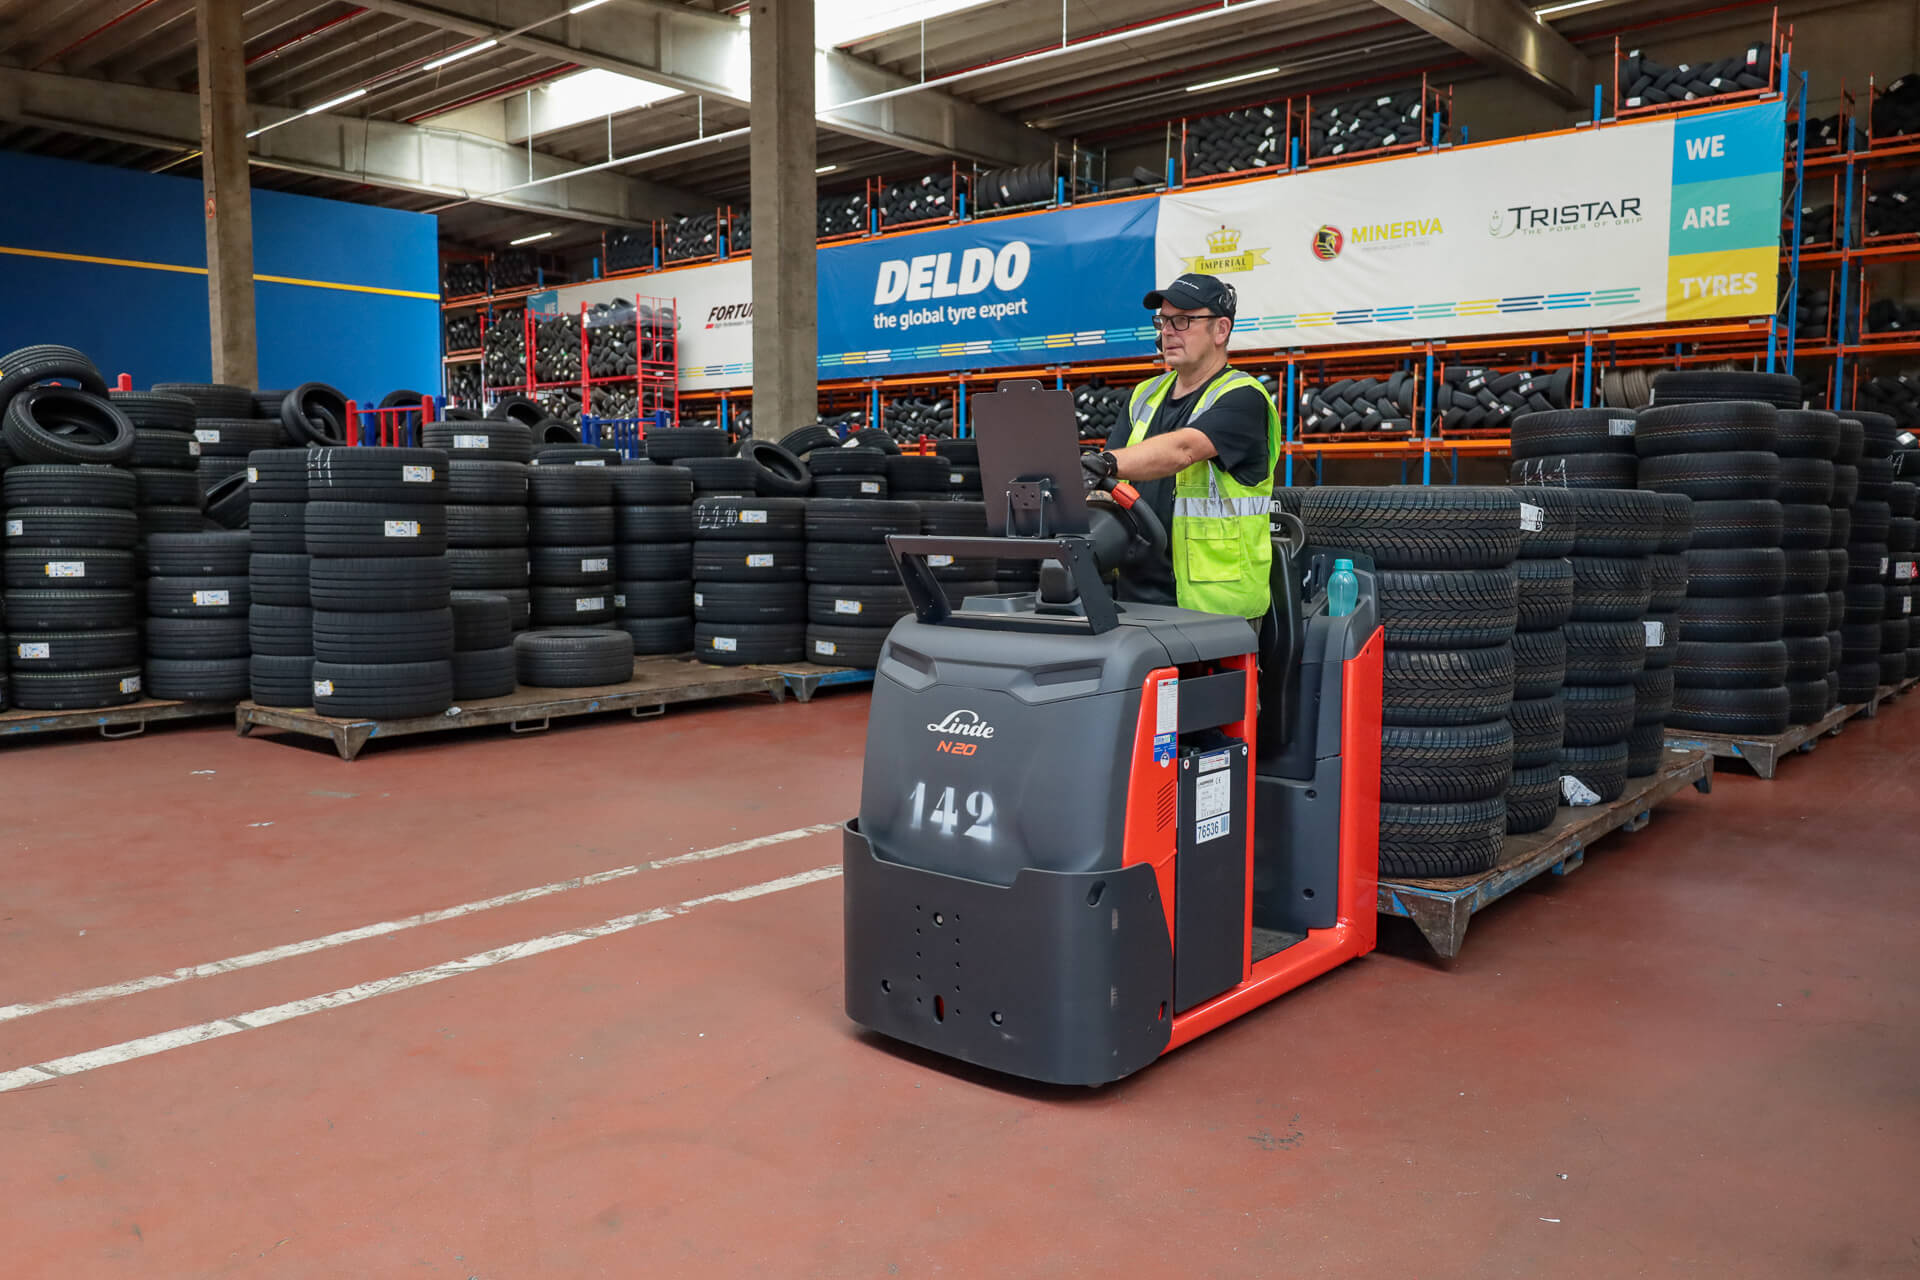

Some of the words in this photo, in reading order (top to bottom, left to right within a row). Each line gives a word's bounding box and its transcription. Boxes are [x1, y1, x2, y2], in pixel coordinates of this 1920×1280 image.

[1686, 134, 1725, 160] WE
[1507, 198, 1641, 229] TRISTAR
[1682, 204, 1730, 230] ARE
[1351, 217, 1443, 244] MINERVA
[873, 241, 1031, 305] DELDO
[1200, 258, 1247, 271] IMPERIAL
[1679, 272, 1758, 299] TYRES
[873, 313, 897, 329] the
[899, 306, 945, 330] global
[947, 306, 977, 325] tyre
[979, 298, 1028, 320] expert
[927, 709, 994, 738] Linde
[909, 782, 995, 843] 142
[1197, 821, 1220, 841] 76536
